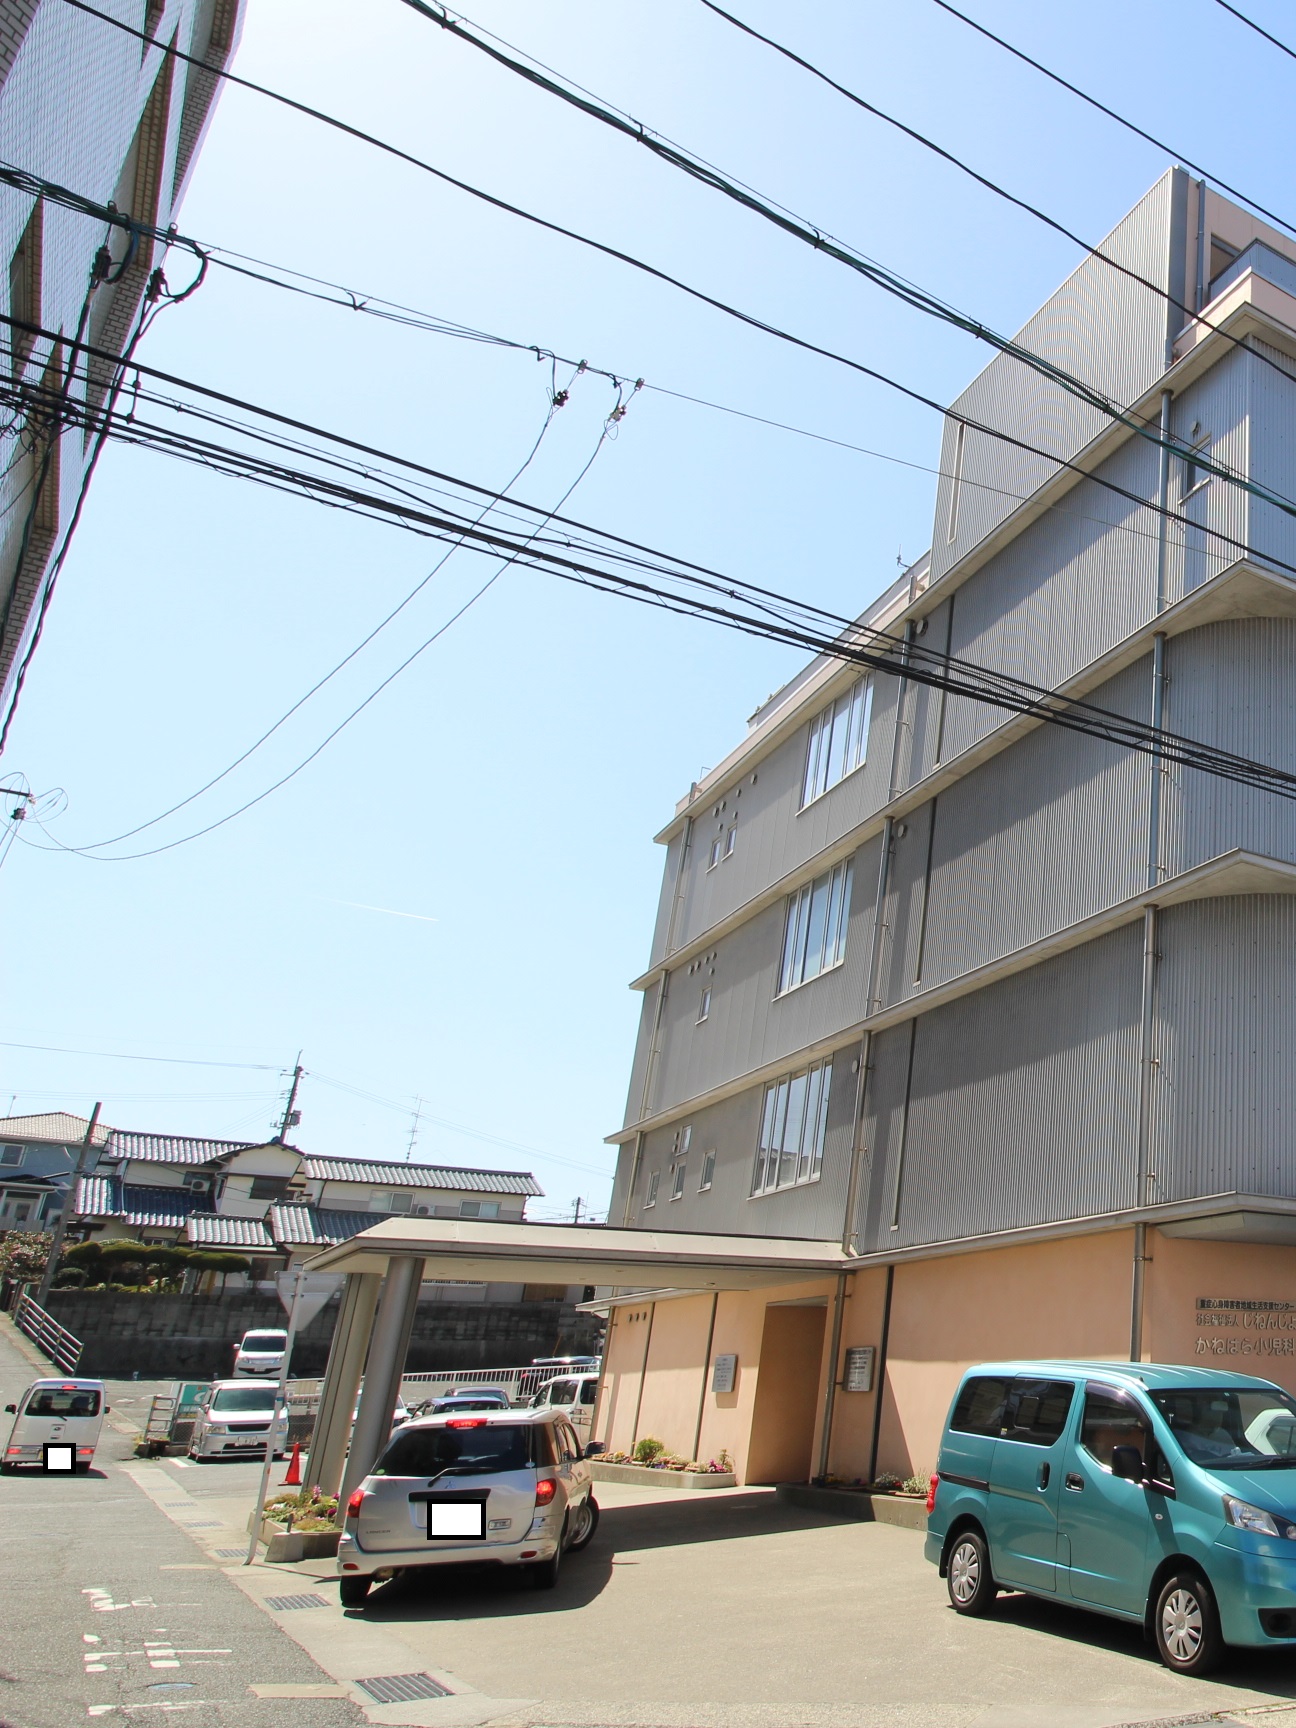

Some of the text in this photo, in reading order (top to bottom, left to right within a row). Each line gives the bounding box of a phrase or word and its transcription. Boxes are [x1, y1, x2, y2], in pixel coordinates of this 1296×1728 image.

[1200, 1299, 1295, 1310] 重症心身障害者地域生活支援センター
[1196, 1313, 1296, 1330] 社会福祉法人 じねんじょ
[1195, 1336, 1295, 1356] かねはら小児科
